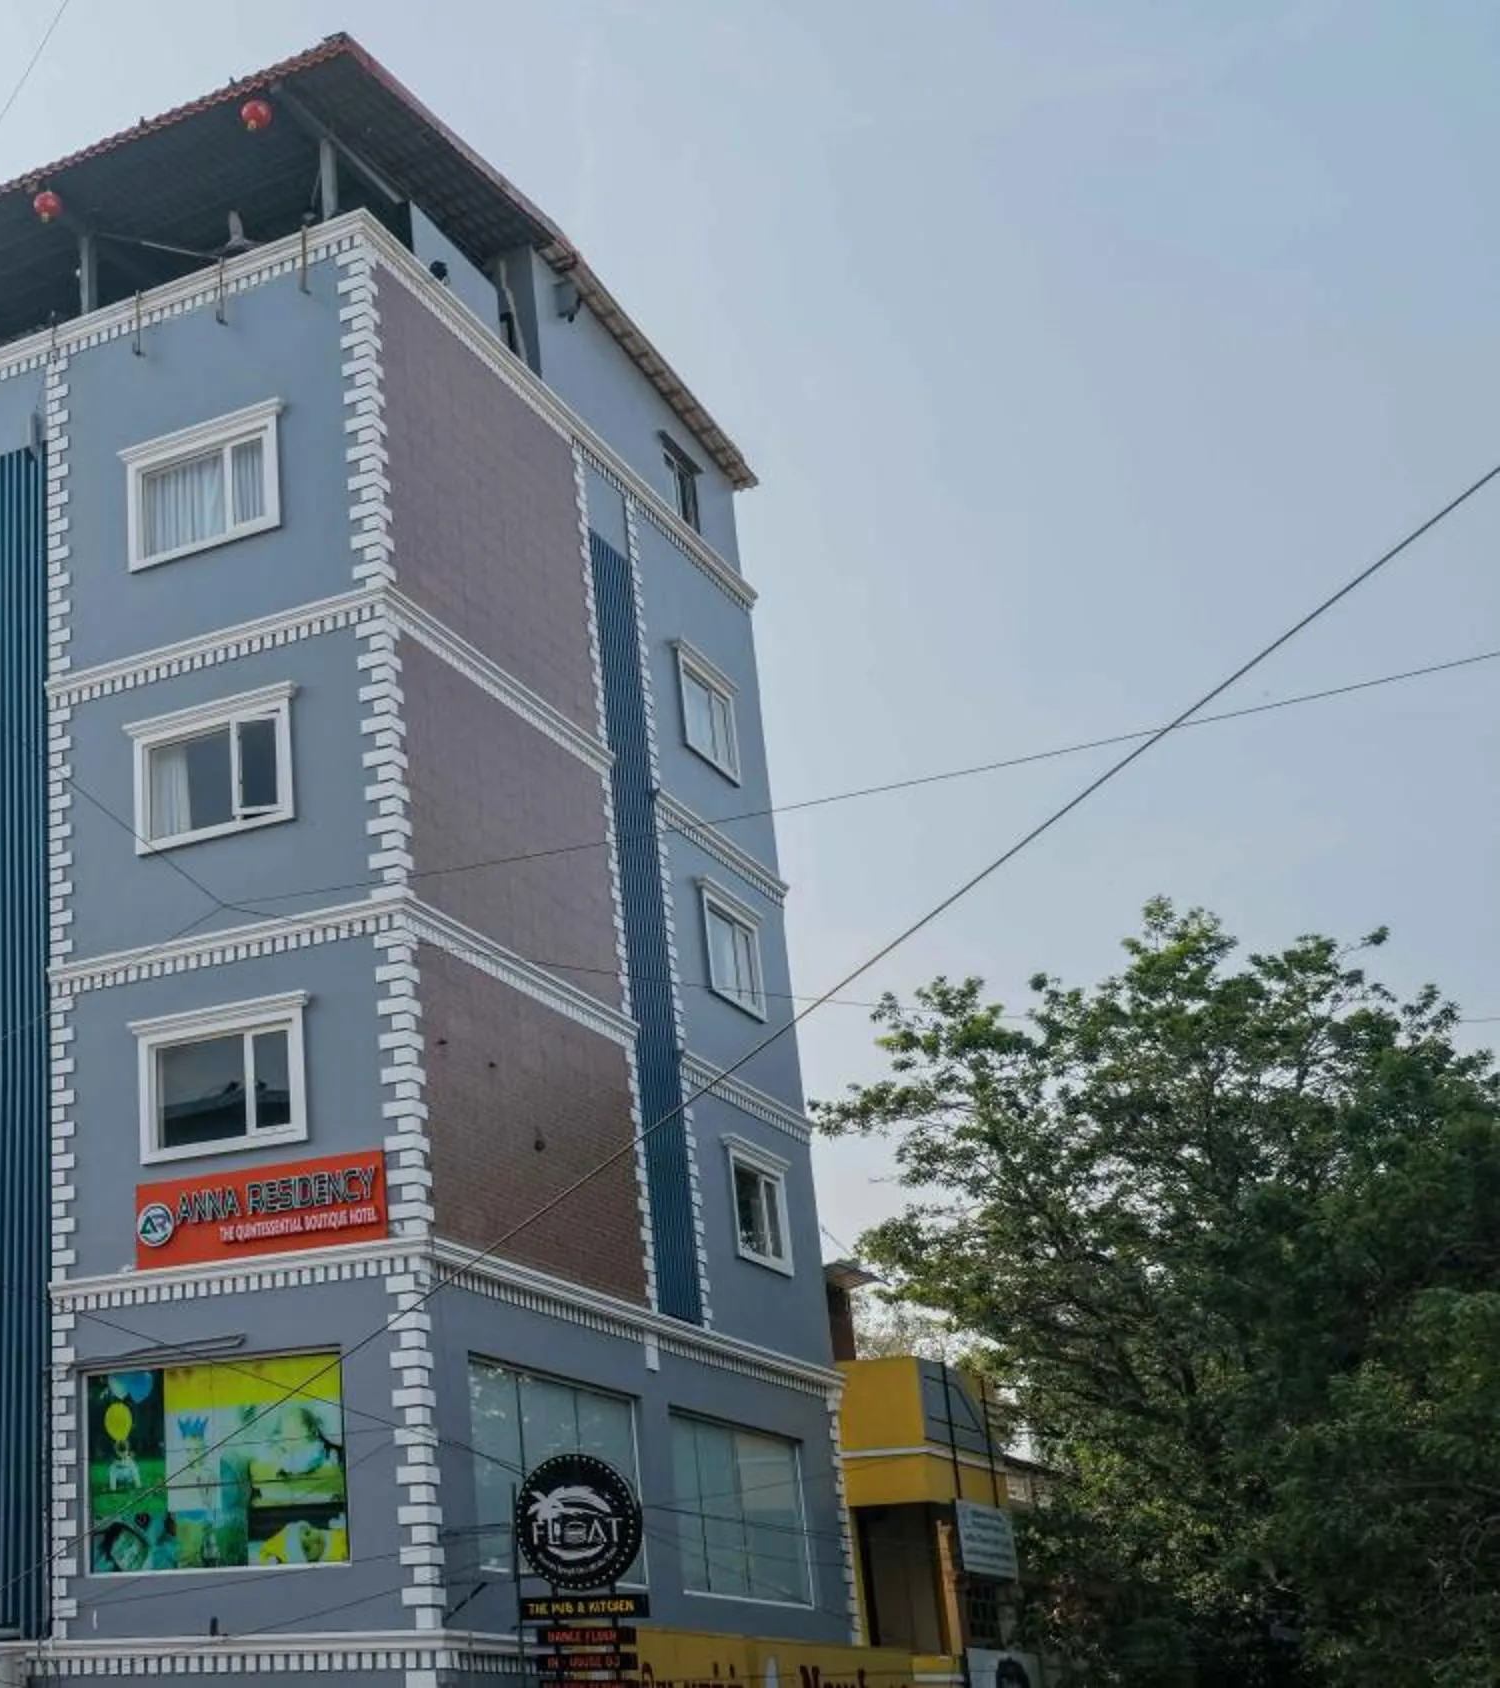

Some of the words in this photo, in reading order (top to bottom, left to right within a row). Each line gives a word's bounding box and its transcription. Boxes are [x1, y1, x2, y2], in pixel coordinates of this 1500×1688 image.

[176, 1184, 240, 1223] ANNA
[247, 1165, 376, 1215] RESIDENCY
[219, 1224, 235, 1242] THE
[304, 1210, 348, 1231] BOUTIQUE
[350, 1206, 379, 1224] HOTEL
[528, 1603, 548, 1615] THE
[551, 1601, 573, 1614] PUB
[589, 1599, 635, 1613] KITCHEN
